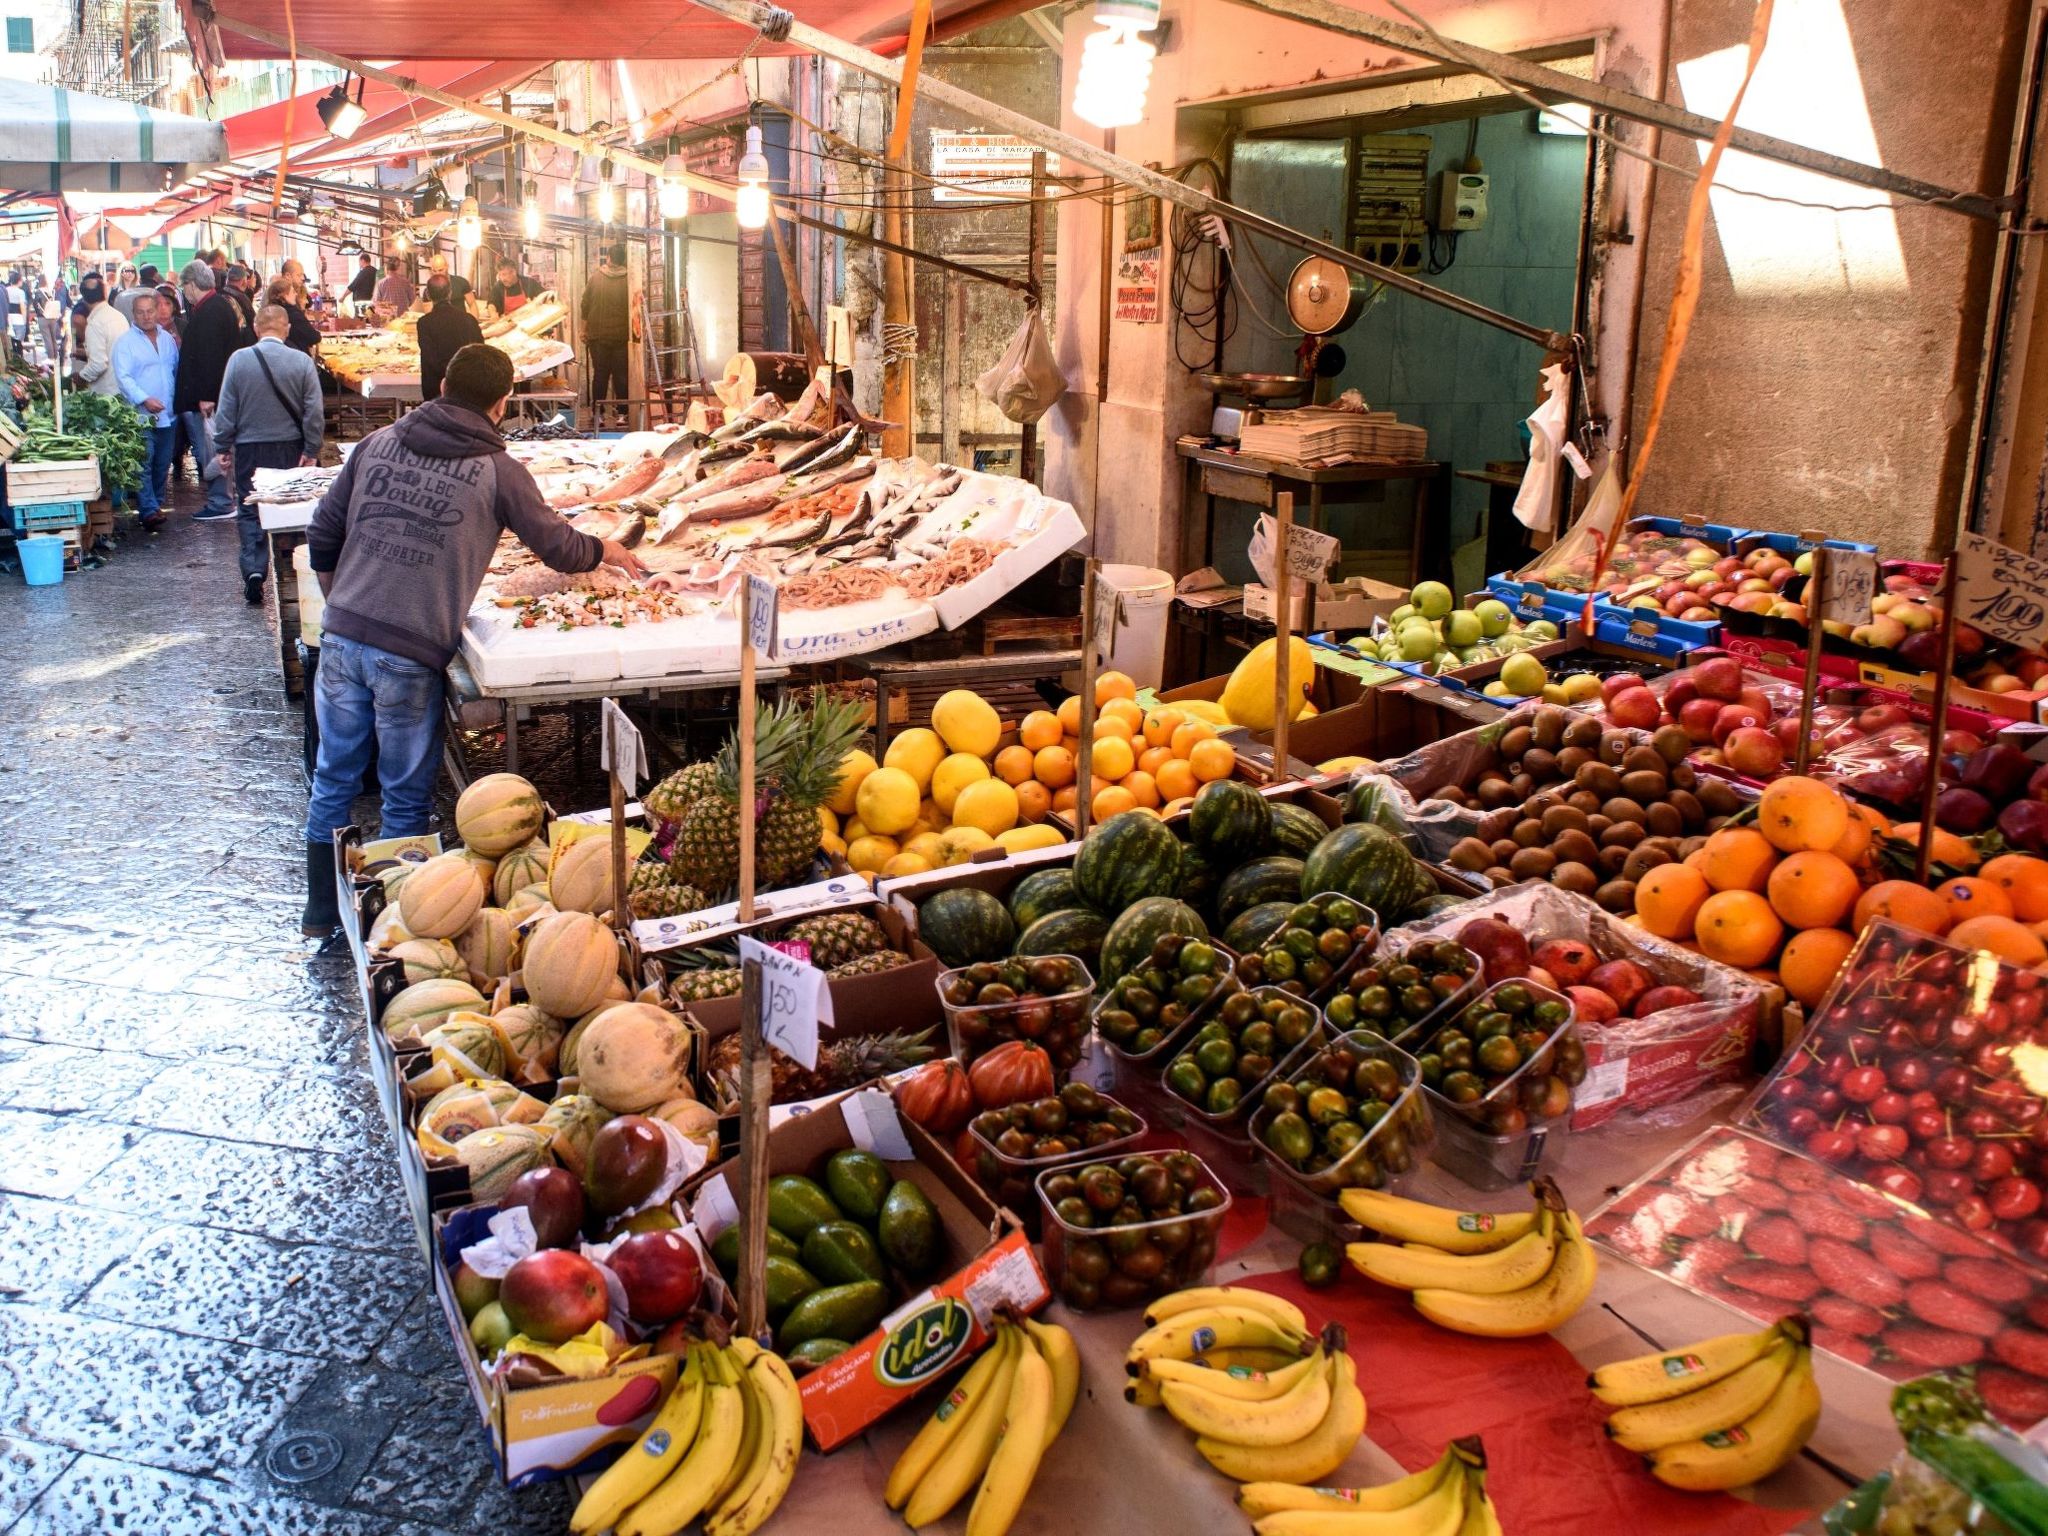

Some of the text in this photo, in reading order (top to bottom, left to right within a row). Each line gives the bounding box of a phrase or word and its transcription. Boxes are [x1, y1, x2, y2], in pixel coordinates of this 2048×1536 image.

[369, 437, 485, 488] LONSDALE
[364, 463, 452, 519] Boxing
[424, 477, 457, 499] LBC
[1516, 605, 1544, 619] Marlene
[1624, 633, 1657, 649] Marlene
[889, 1297, 957, 1374] idol
[832, 1351, 871, 1380] AVOCADO
[826, 1371, 857, 1394] AVOCAT
